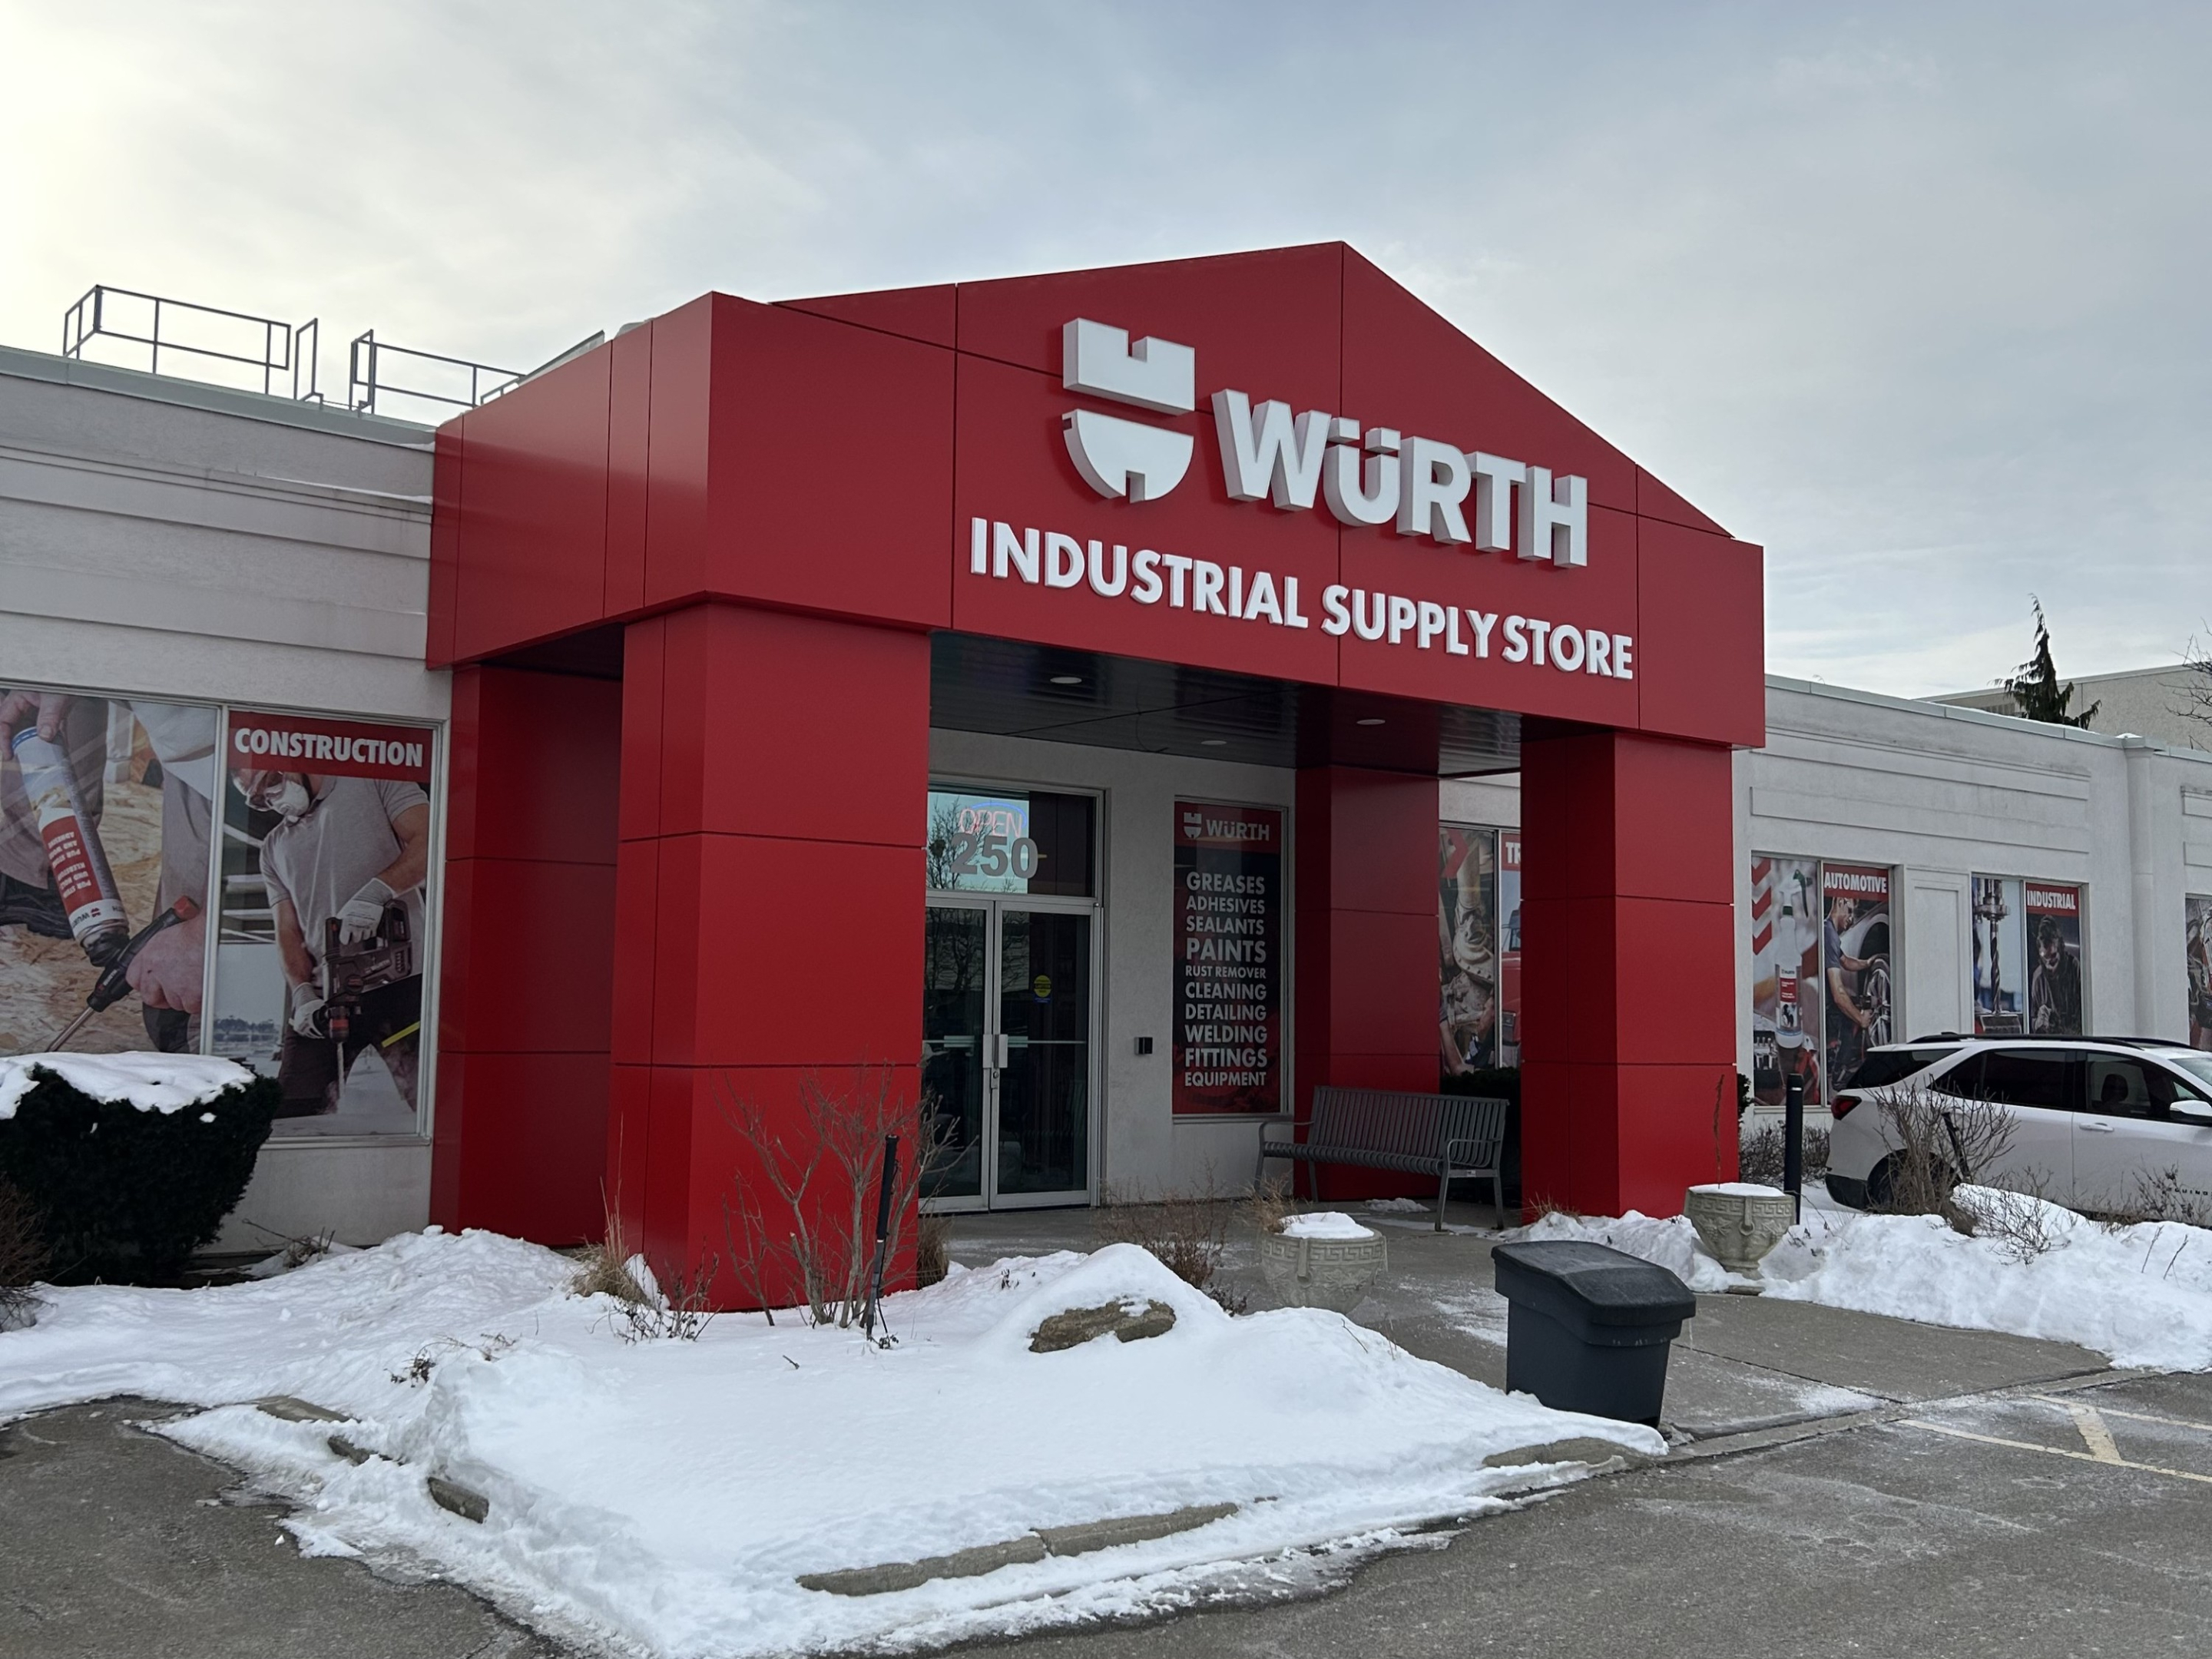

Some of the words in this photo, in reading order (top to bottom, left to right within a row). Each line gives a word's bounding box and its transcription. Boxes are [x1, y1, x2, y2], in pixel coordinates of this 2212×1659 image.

[1212, 389, 1588, 569] WÜRTH
[970, 517, 1309, 629] INDUSTRIAL
[1322, 584, 1498, 659] SUPPLY
[1502, 615, 1634, 680] STORE
[233, 727, 424, 767] CONSTRUCTION
[959, 806, 1022, 838] OPEN
[1206, 818, 1270, 842] WÜRTH
[950, 832, 1038, 879] 250
[1186, 871, 1265, 895] GREASES
[1823, 871, 1888, 894] AUTOMOTIVE
[1186, 896, 1265, 915] ADHESIVES
[2026, 889, 2076, 910] INDUSTRIAL
[1186, 915, 1265, 935] SEALANTS
[1186, 937, 1267, 963] PAINTS
[1185, 965, 1214, 978] RUST
[1215, 965, 1267, 979] REMOVER
[1185, 981, 1267, 1001] CLEANING
[1185, 1003, 1267, 1022] DETAILING
[1185, 1025, 1267, 1044] WELDING
[1185, 1048, 1267, 1068] FITTINGS
[1184, 1071, 1267, 1088] EQUIPMENT
